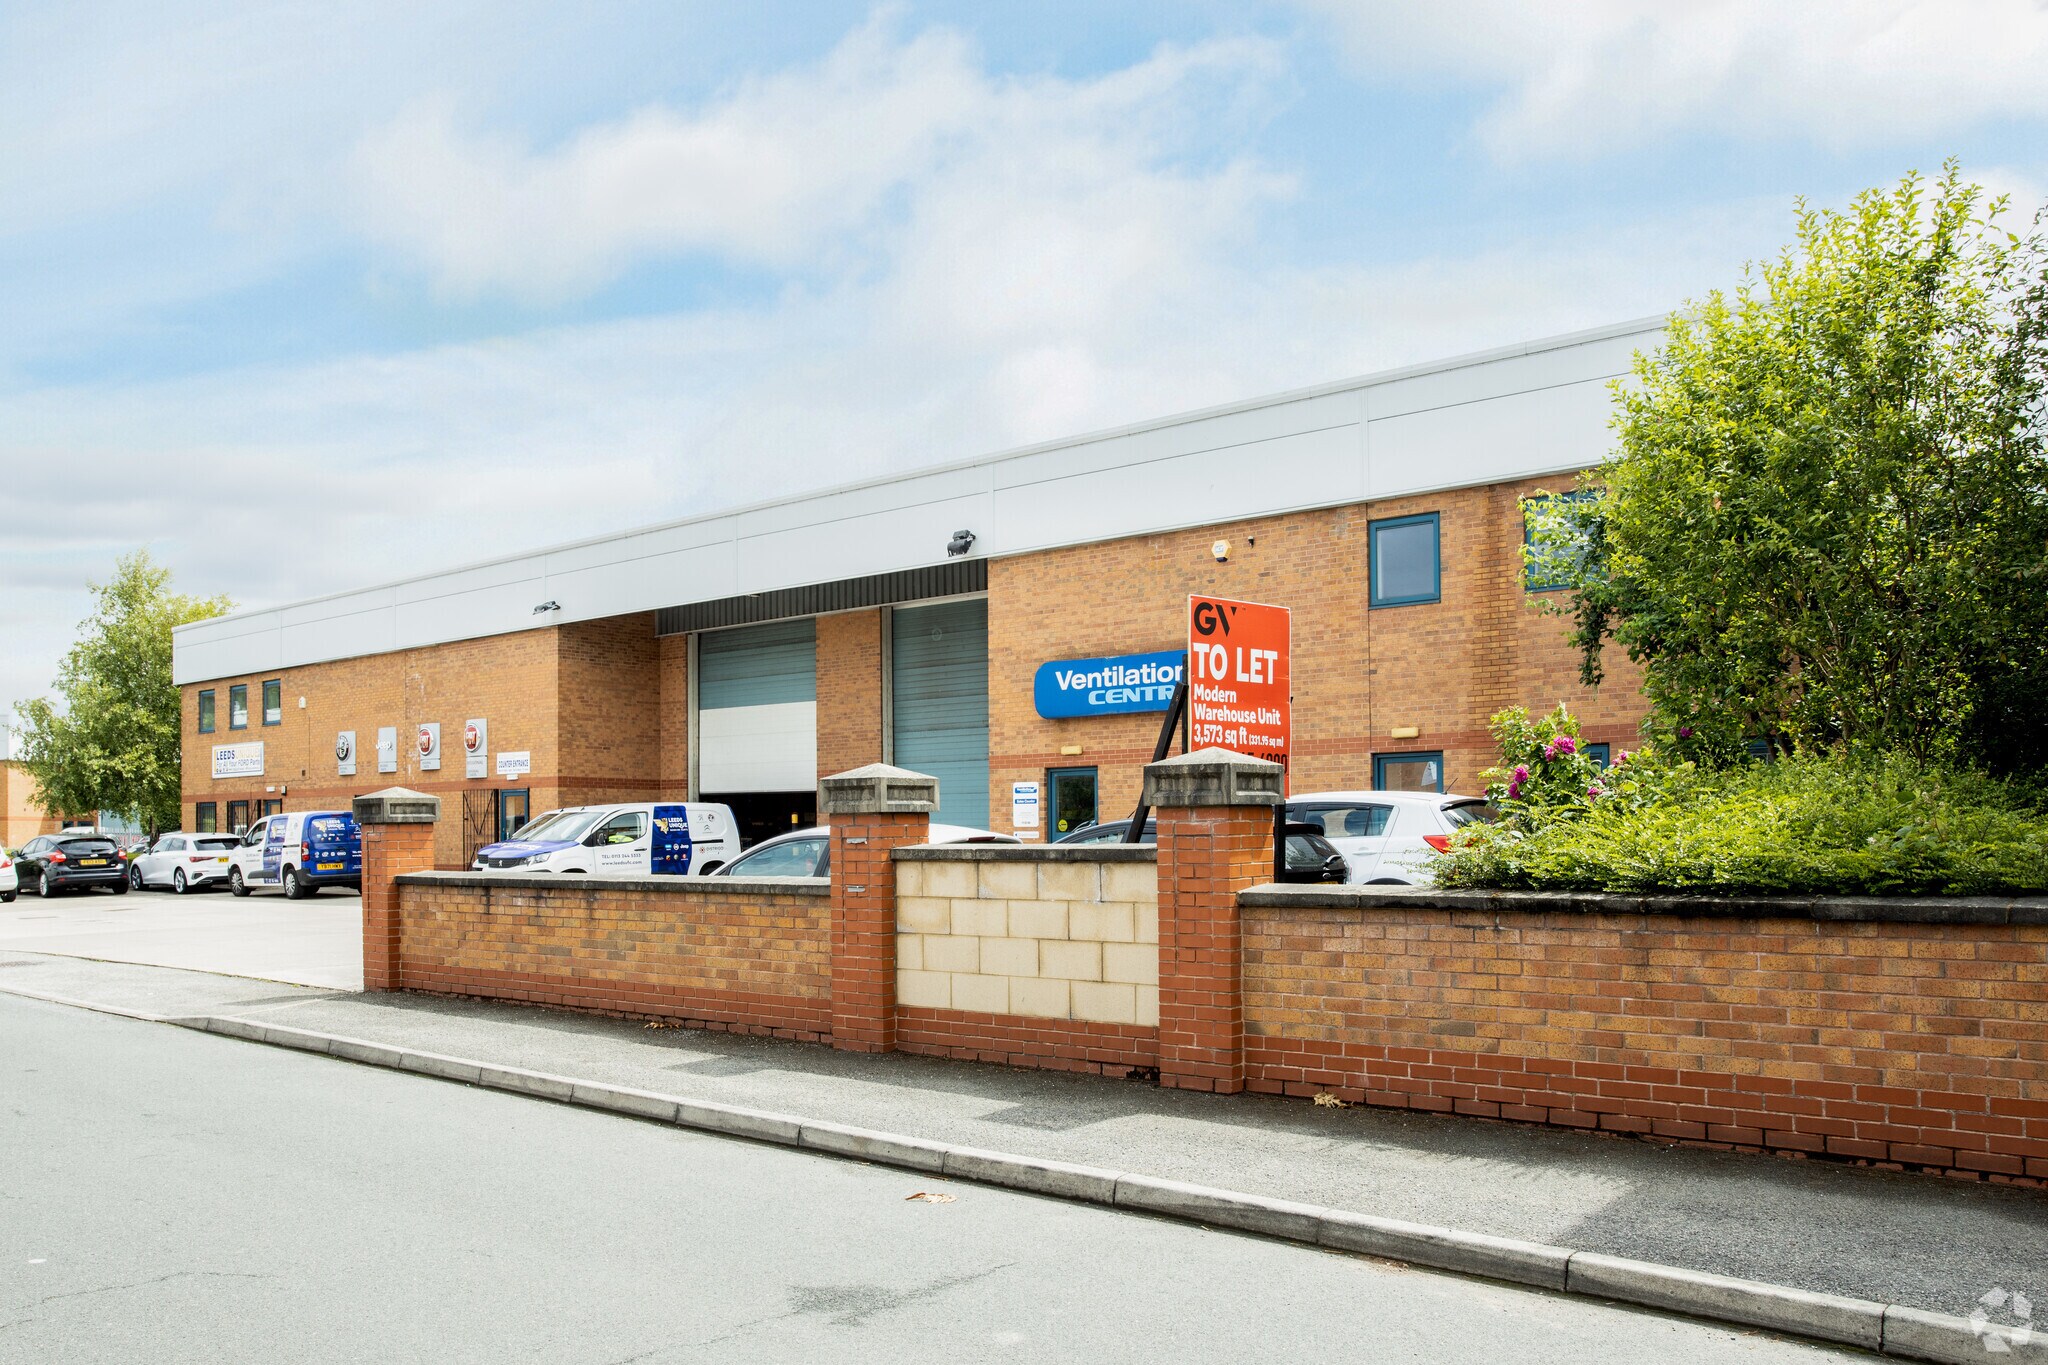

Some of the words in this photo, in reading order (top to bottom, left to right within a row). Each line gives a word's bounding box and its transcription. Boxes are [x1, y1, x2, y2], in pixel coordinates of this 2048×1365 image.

[1193, 642, 1228, 680] TO
[1236, 647, 1278, 685] LET
[1194, 683, 1237, 703] Modern
[1194, 703, 1256, 723] Warehouse
[1258, 707, 1281, 725] Unit
[1194, 724, 1223, 746] 3,573
[1225, 729, 1237, 748] sq
[1239, 726, 1247, 744] ft
[1249, 734, 1268, 746] (331.95
[1268, 737, 1276, 748] sq
[1276, 736, 1284, 747] m)
[216, 750, 235, 761] LEEDS
